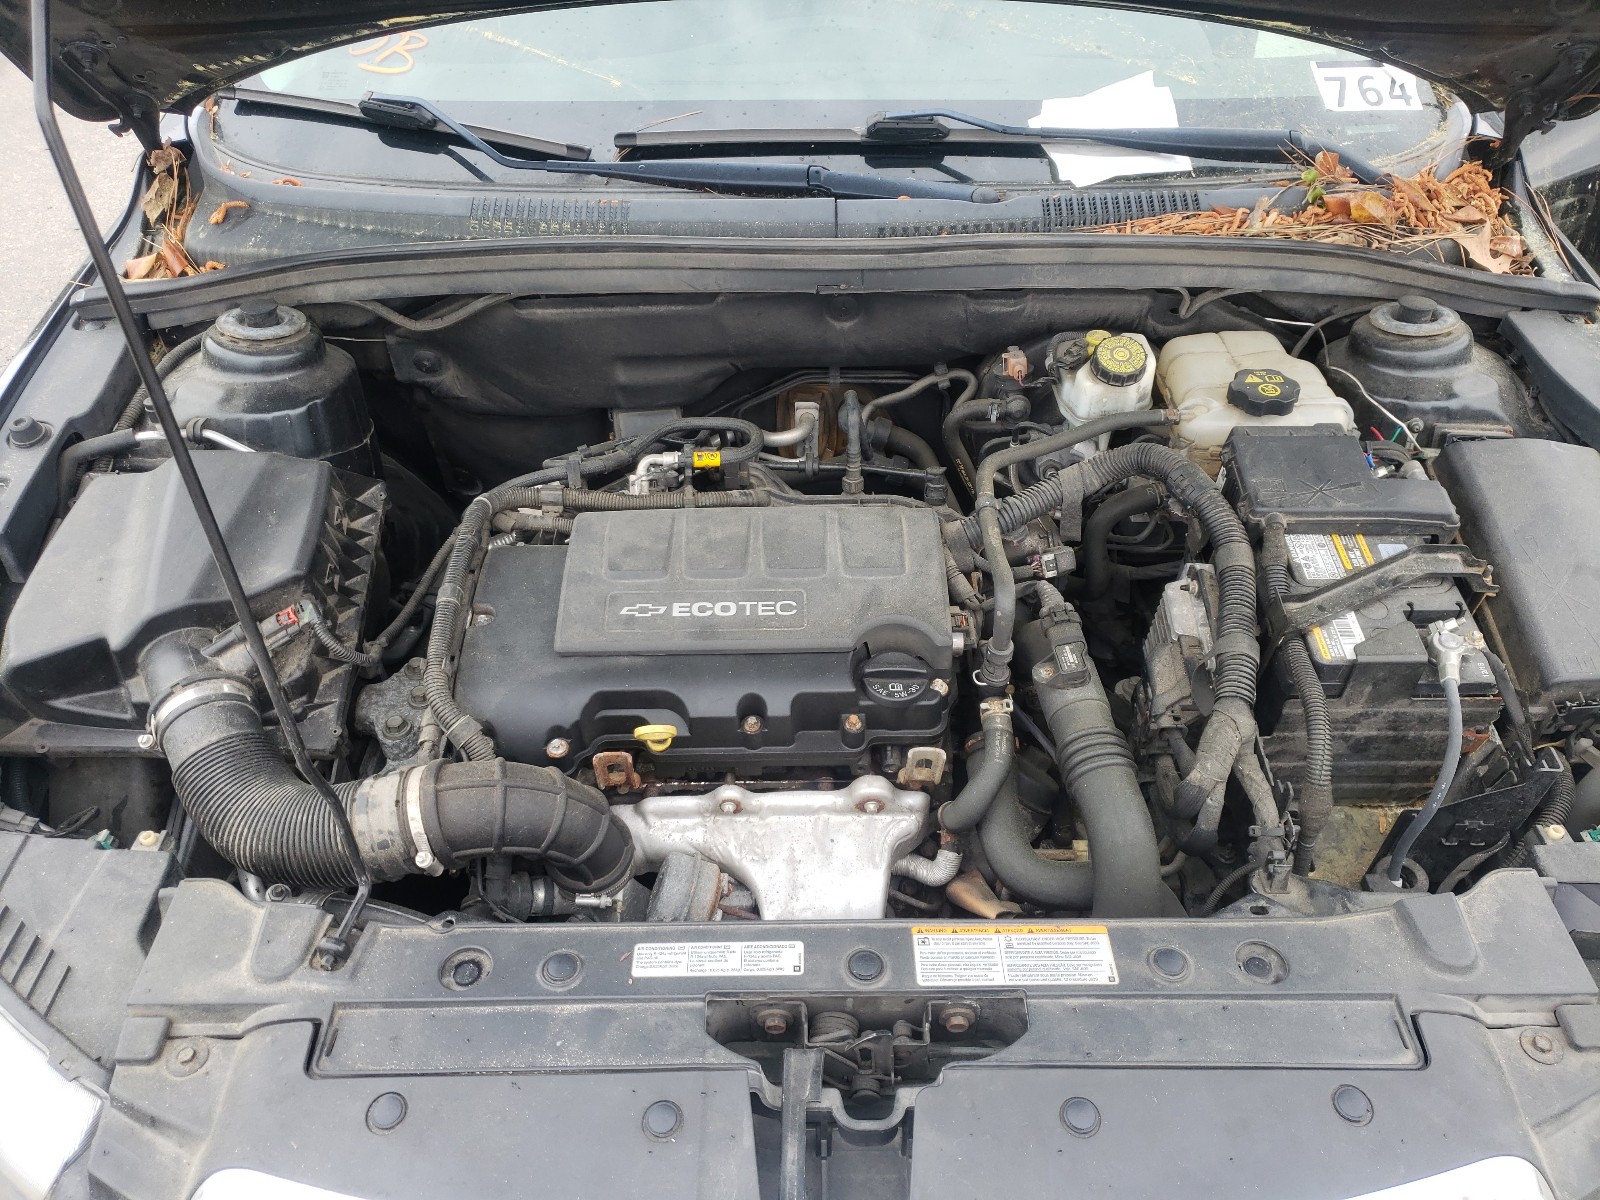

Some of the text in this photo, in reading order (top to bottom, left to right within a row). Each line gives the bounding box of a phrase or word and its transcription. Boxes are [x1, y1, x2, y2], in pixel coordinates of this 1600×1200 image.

[1324, 75, 1412, 108] 764
[672, 600, 798, 617] ECOTEC
[872, 683, 920, 698] SAE 5W-30
